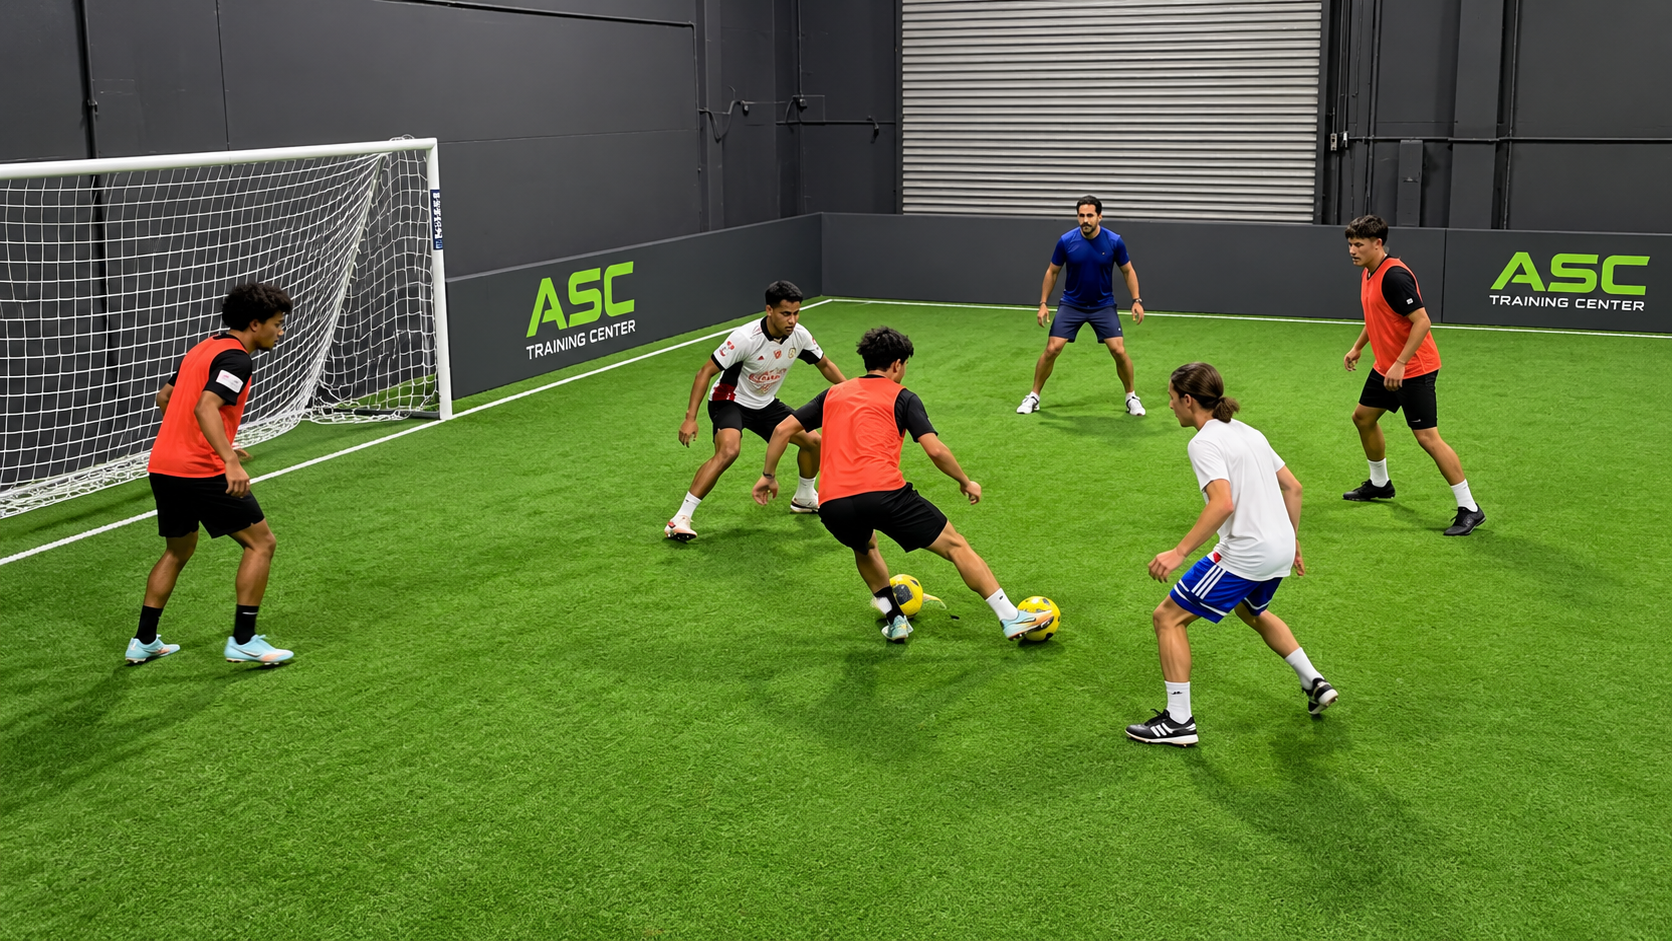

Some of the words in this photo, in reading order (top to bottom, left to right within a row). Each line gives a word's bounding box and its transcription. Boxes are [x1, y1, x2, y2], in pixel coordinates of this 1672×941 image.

[1490, 252, 1650, 295] ASC
[526, 261, 634, 338] ASC
[1489, 295, 1569, 308] TRAINING
[1575, 298, 1645, 311] CENTER
[526, 333, 586, 360] TRAINING
[589, 320, 635, 343] CENTER
